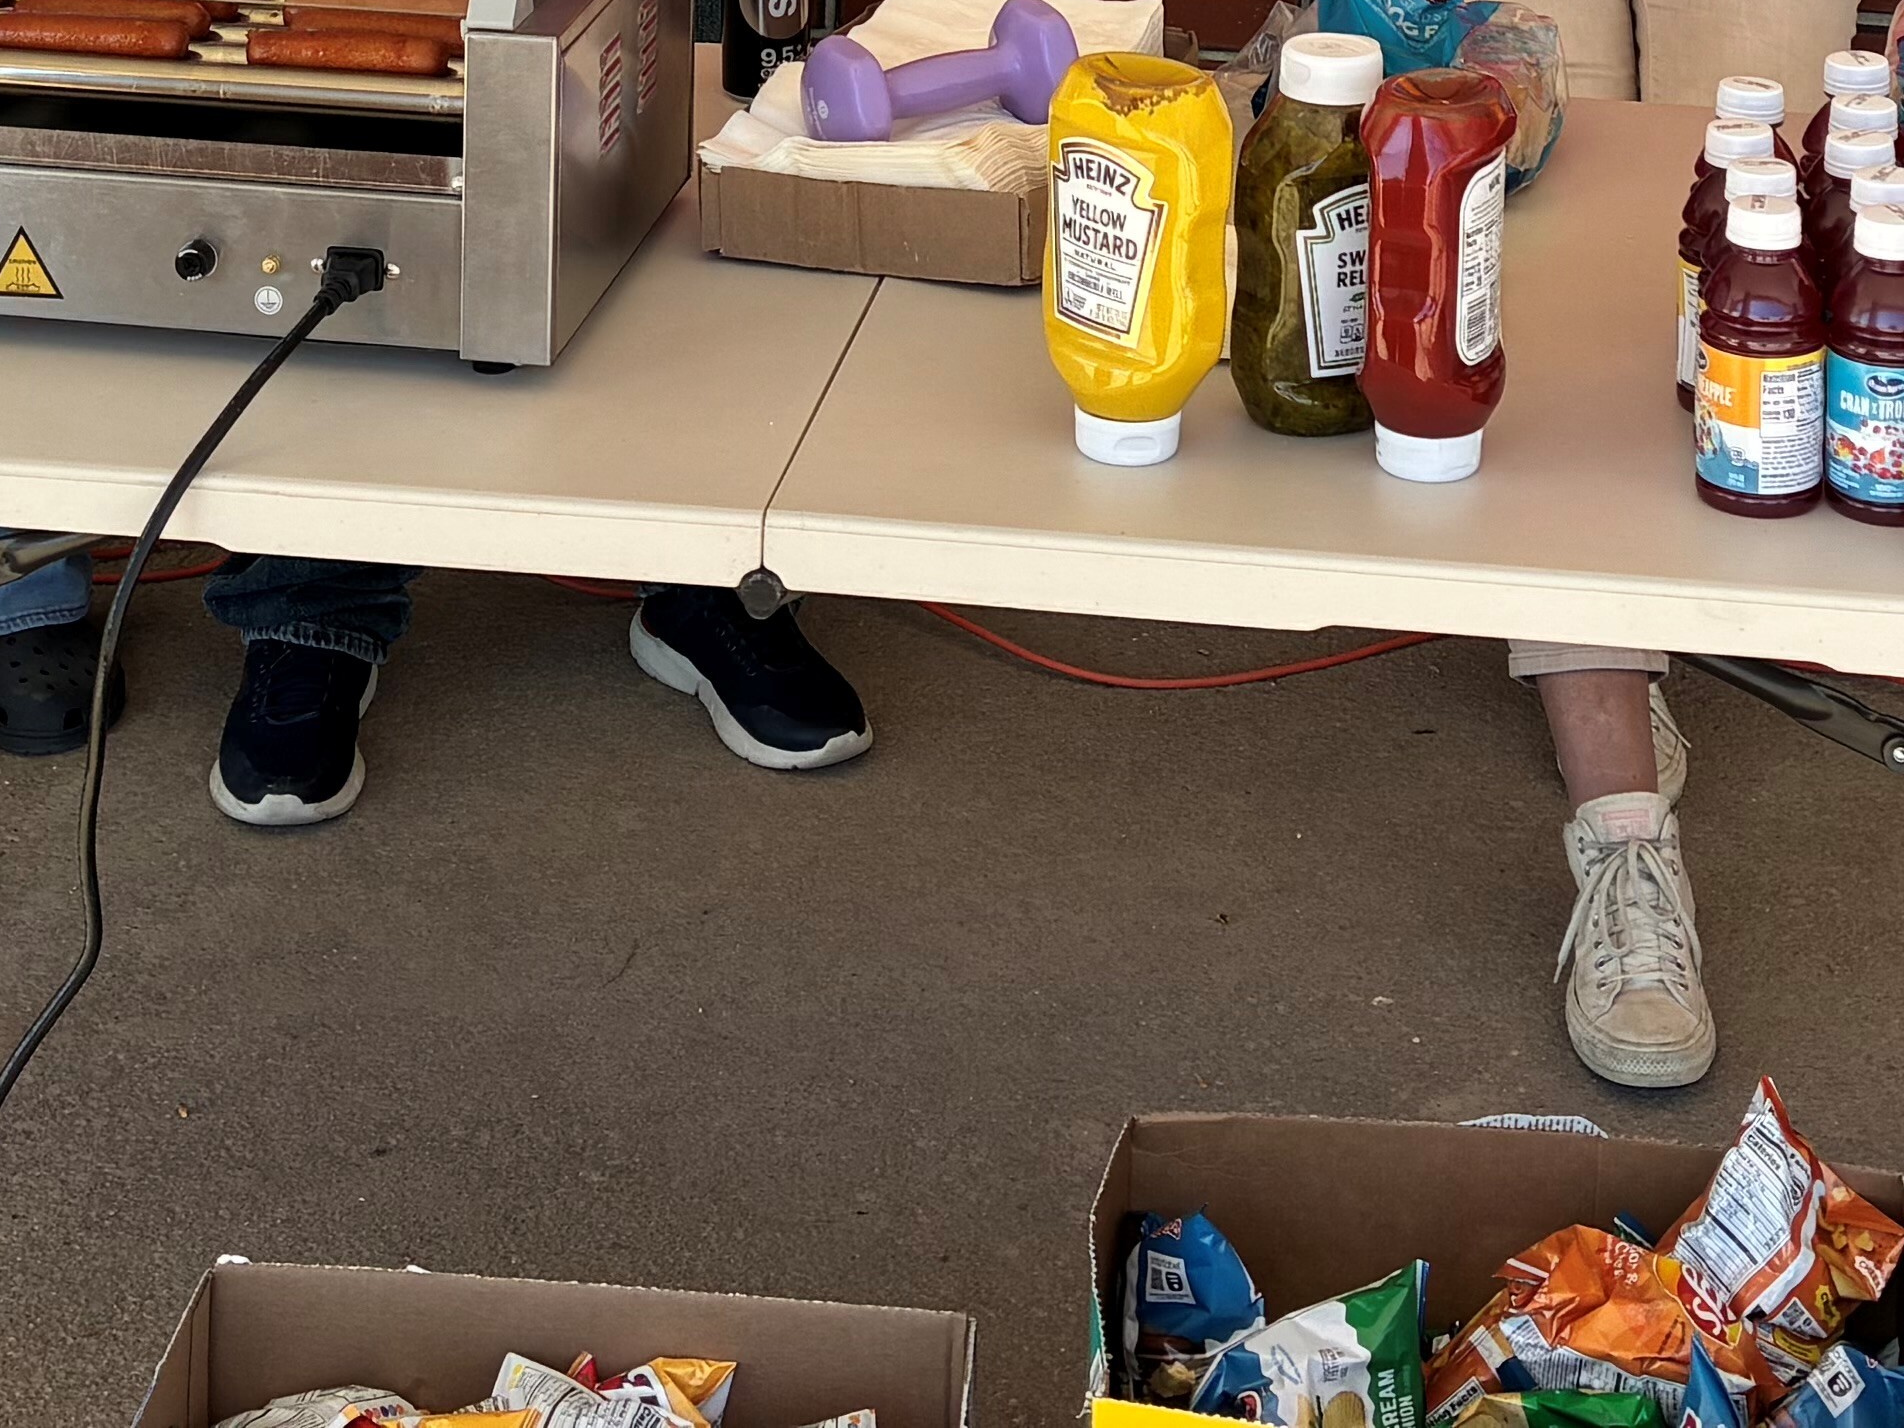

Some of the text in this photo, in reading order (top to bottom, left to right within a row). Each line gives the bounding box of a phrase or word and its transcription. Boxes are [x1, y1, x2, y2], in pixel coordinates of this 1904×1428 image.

[1072, 157, 1131, 197] HEINZ
[1071, 194, 1127, 233] YELLOW
[1062, 213, 1138, 261] MUSTARD
[1840, 390, 1870, 417] CRAN
[1377, 1367, 1397, 1428] REAM
